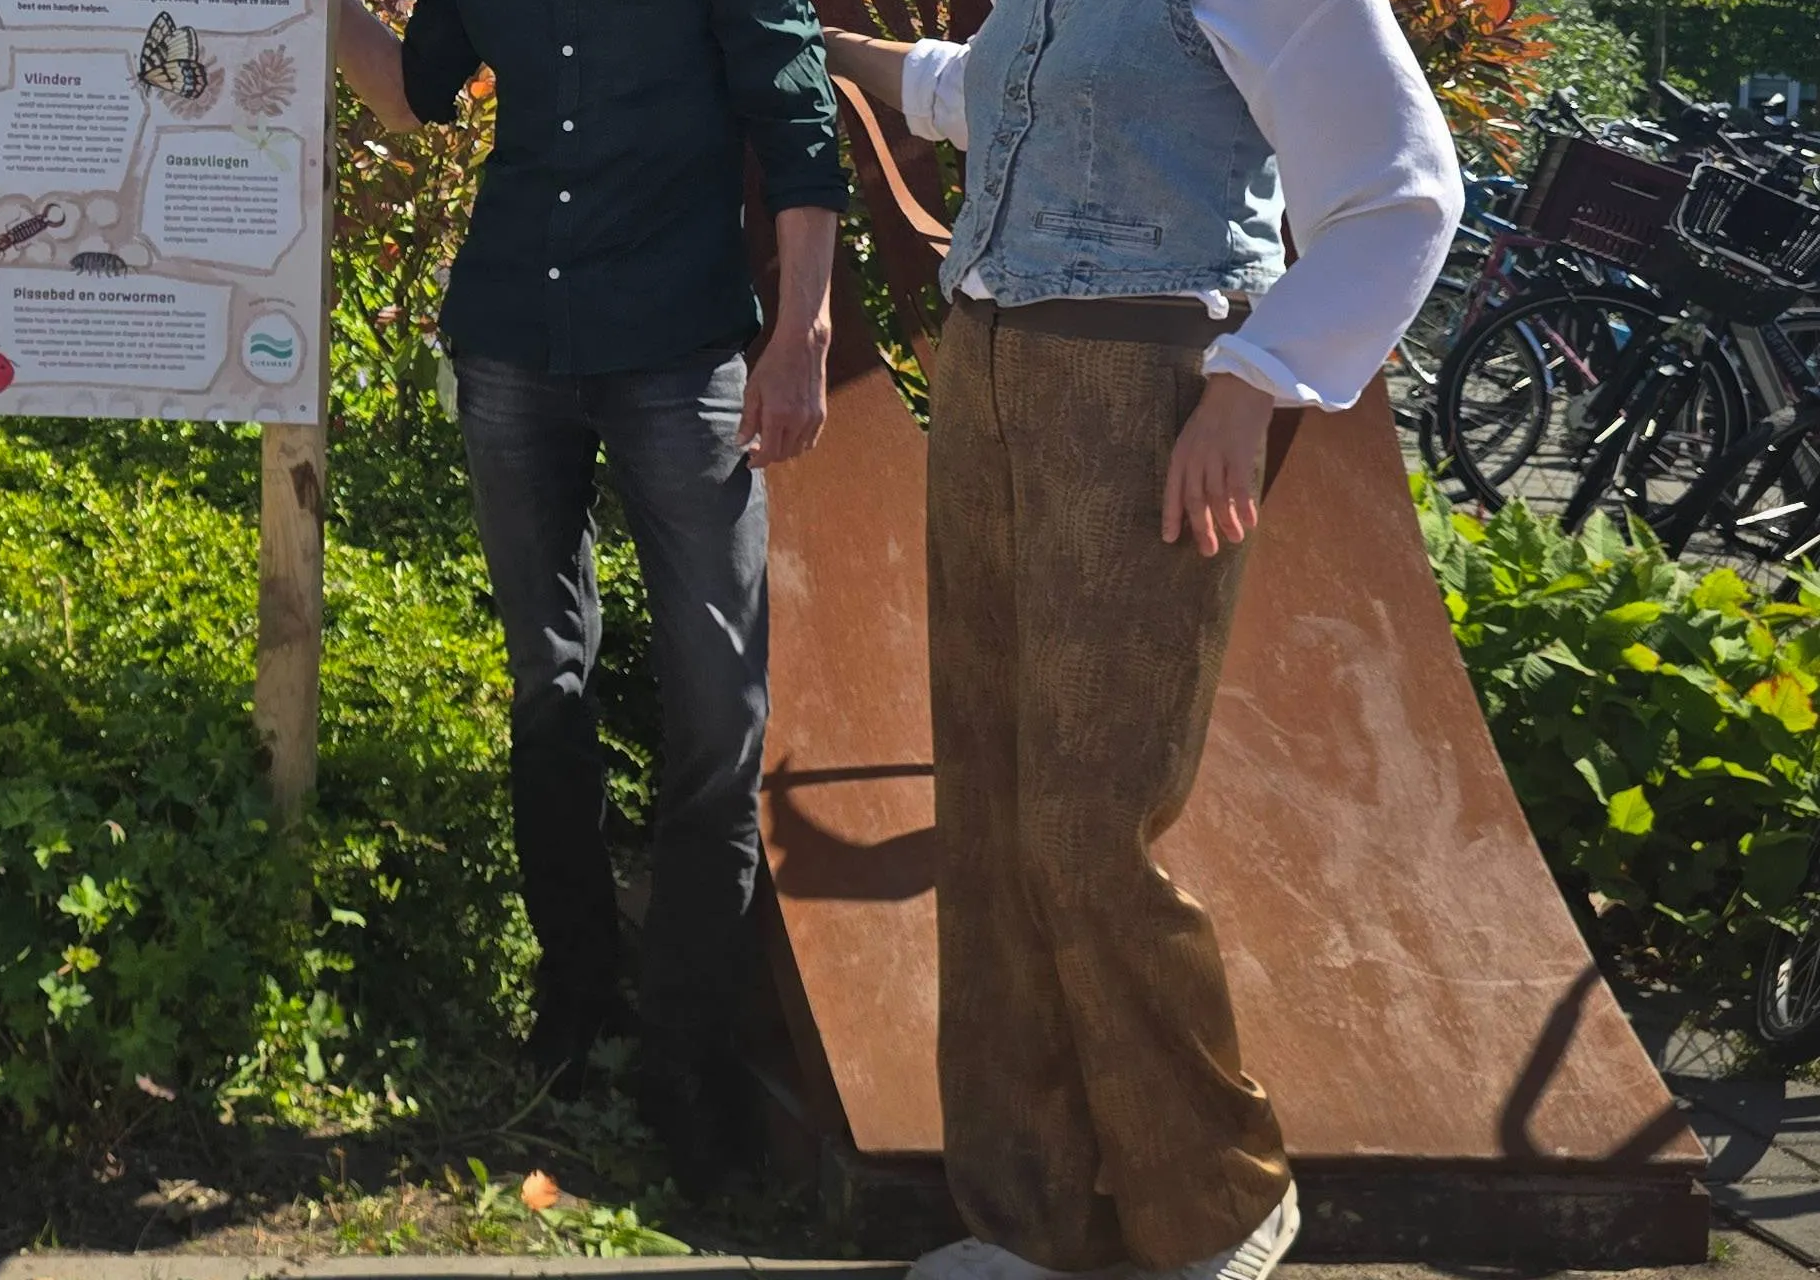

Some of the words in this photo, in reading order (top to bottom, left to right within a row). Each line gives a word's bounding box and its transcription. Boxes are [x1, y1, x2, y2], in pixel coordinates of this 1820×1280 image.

[17, 2, 36, 10] best
[52, 3, 79, 13] handje
[24, 73, 82, 86] Vlinders
[166, 154, 249, 170] Gaasvliegen
[14, 288, 74, 300] Pissebed
[79, 290, 95, 302] en
[98, 291, 176, 304] oorwormen
